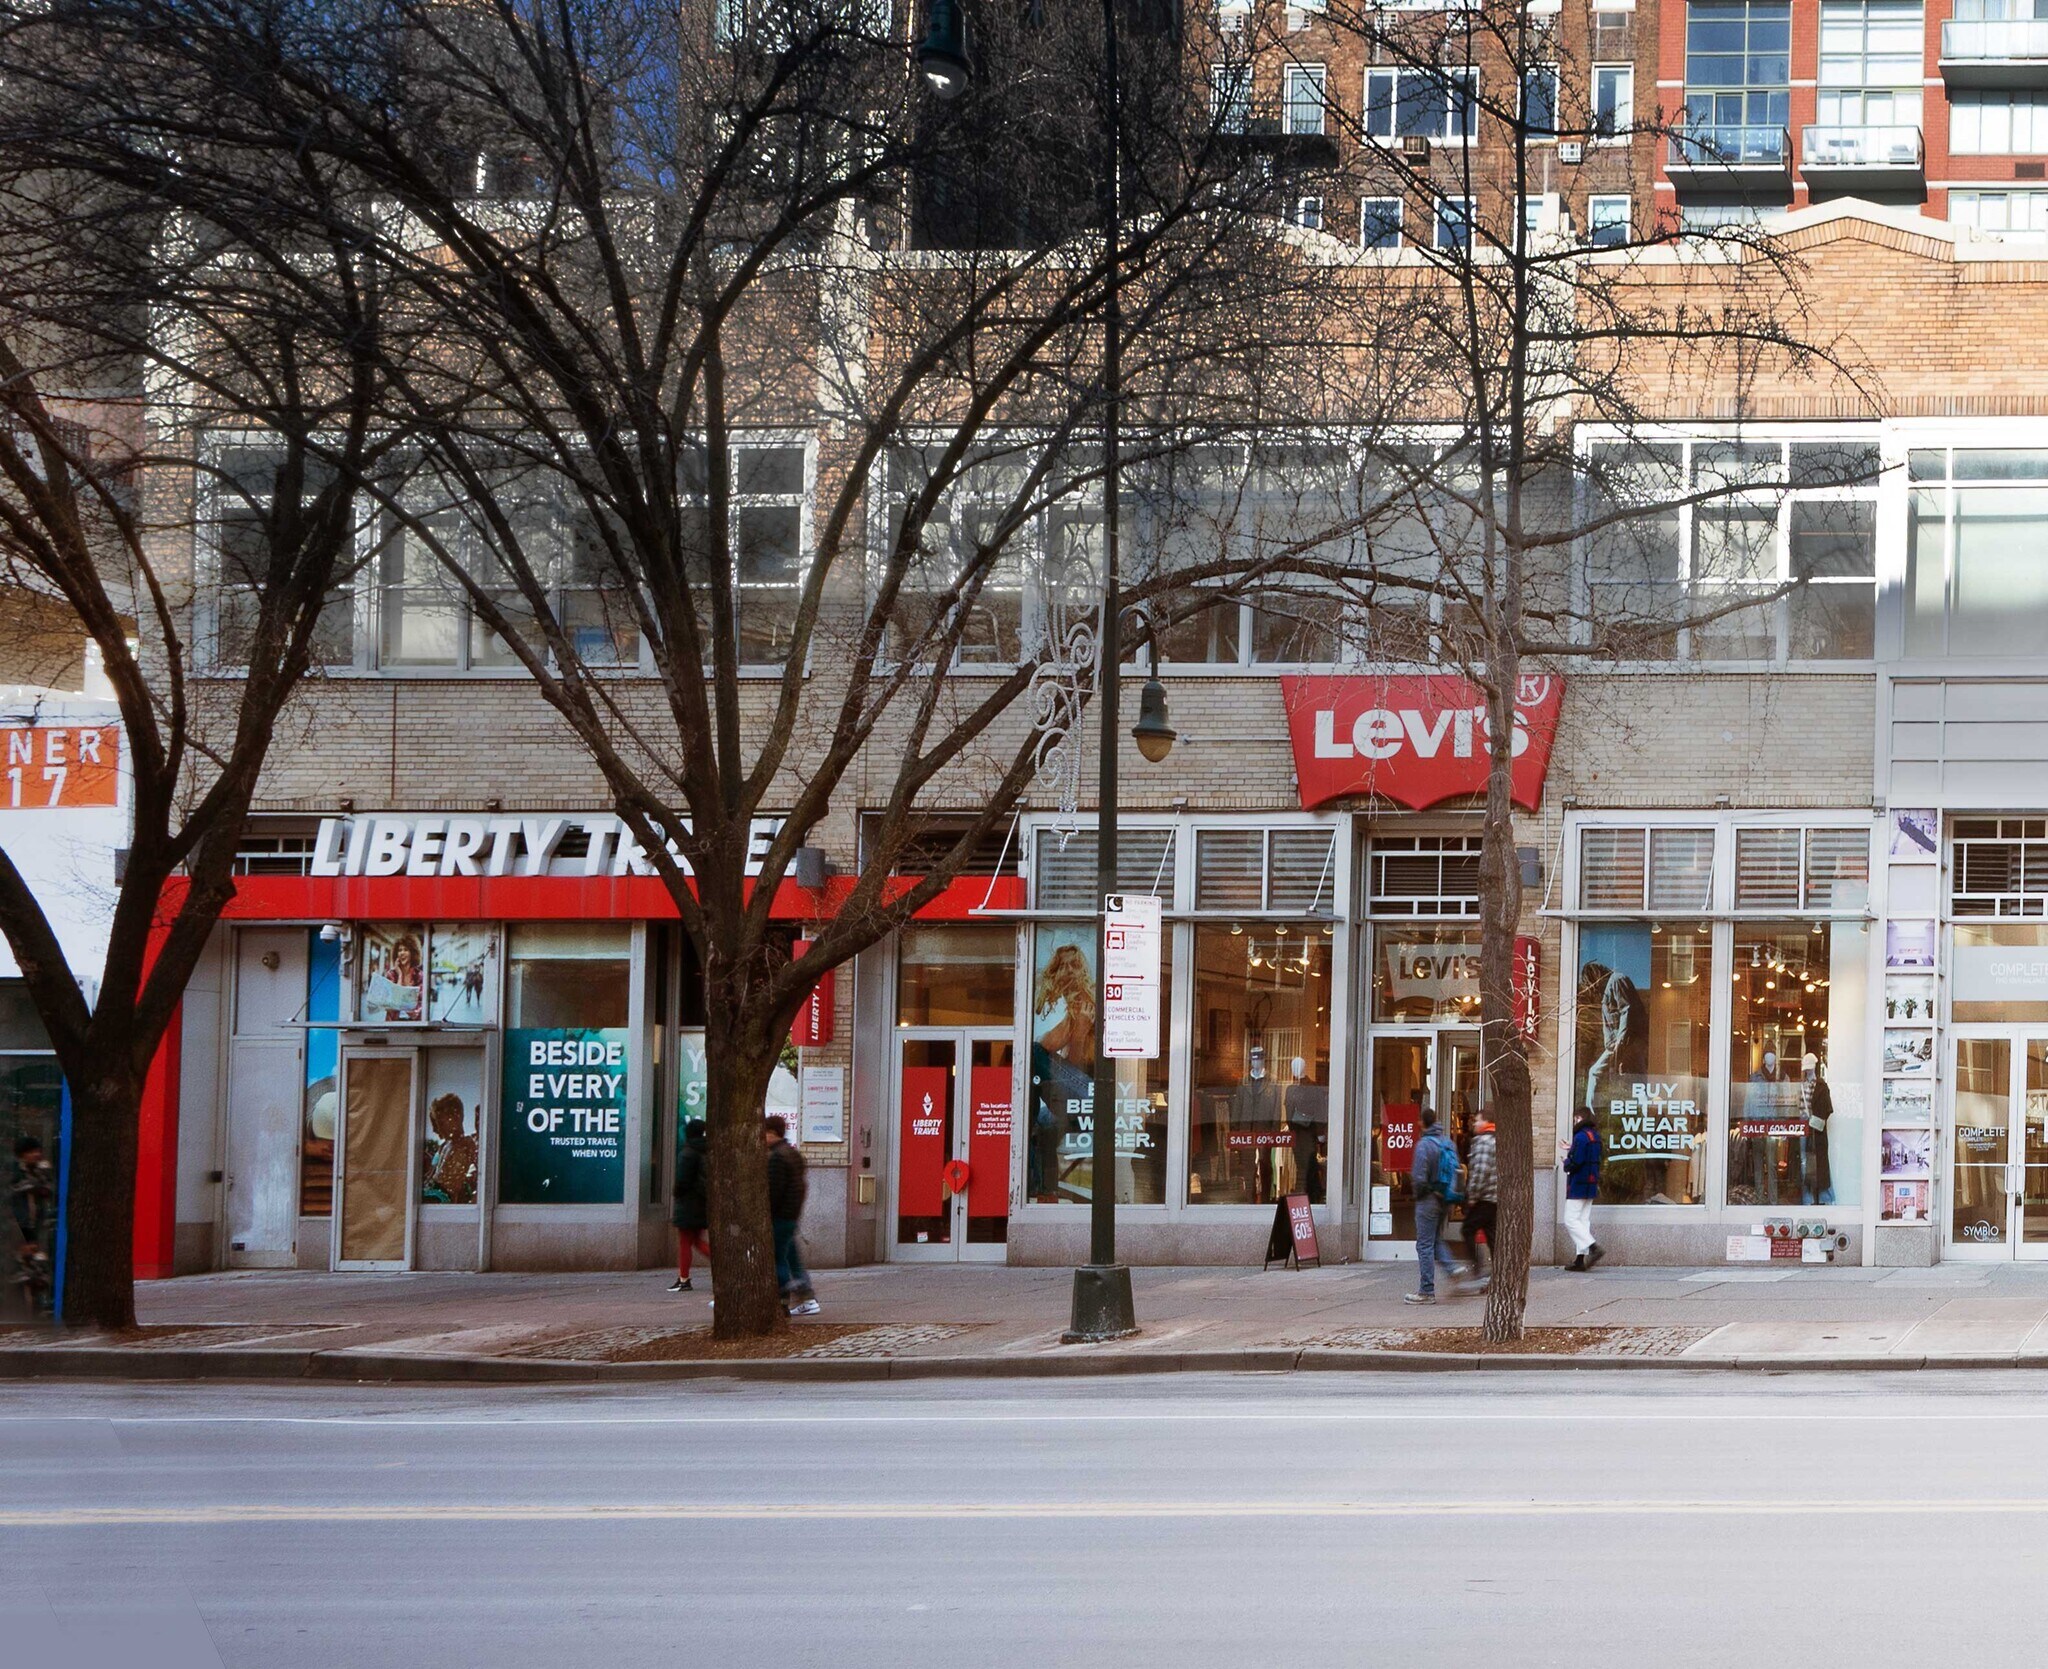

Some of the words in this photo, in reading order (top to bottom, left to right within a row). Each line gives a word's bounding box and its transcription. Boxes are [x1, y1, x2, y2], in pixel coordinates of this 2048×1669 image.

[310, 818, 566, 877] LIBERTY
[1107, 986, 1122, 999] 30
[1107, 1006, 1145, 1014] COMMERCIAL
[811, 994, 820, 1041] LIBERTY
[1107, 1014, 1136, 1022] VEHICLES
[1136, 1014, 1151, 1022] ONLY
[530, 1041, 622, 1065] BESIDE
[529, 1074, 622, 1099] EVERY
[1632, 1082, 1678, 1098] BUY
[1066, 1099, 1156, 1114] BETER.
[1610, 1099, 1701, 1116] BETTER.
[527, 1107, 564, 1133] OF
[569, 1108, 620, 1132] THE
[912, 1119, 943, 1128] LIBERTY
[1077, 1116, 1144, 1131] WAR
[1621, 1117, 1688, 1132] WEAR
[913, 1127, 940, 1136] TRAVEL
[1387, 1123, 1414, 1133] SALE
[1742, 1124, 1765, 1134] SALE
[1769, 1124, 1787, 1133] 60%
[1788, 1124, 1805, 1133] OFF
[1959, 1127, 2006, 1137] COMPLETE
[550, 1137, 585, 1146] TRUSTED
[587, 1137, 617, 1146] TRAVEL
[1230, 1136, 1252, 1145] SALE
[1256, 1136, 1274, 1145] 60%
[1275, 1135, 1292, 1144] OFF
[571, 1150, 597, 1158] WHEN
[599, 1149, 617, 1158] YOU
[1291, 1206, 1309, 1219] SALE
[1963, 1225, 1999, 1237] SYMBIO
